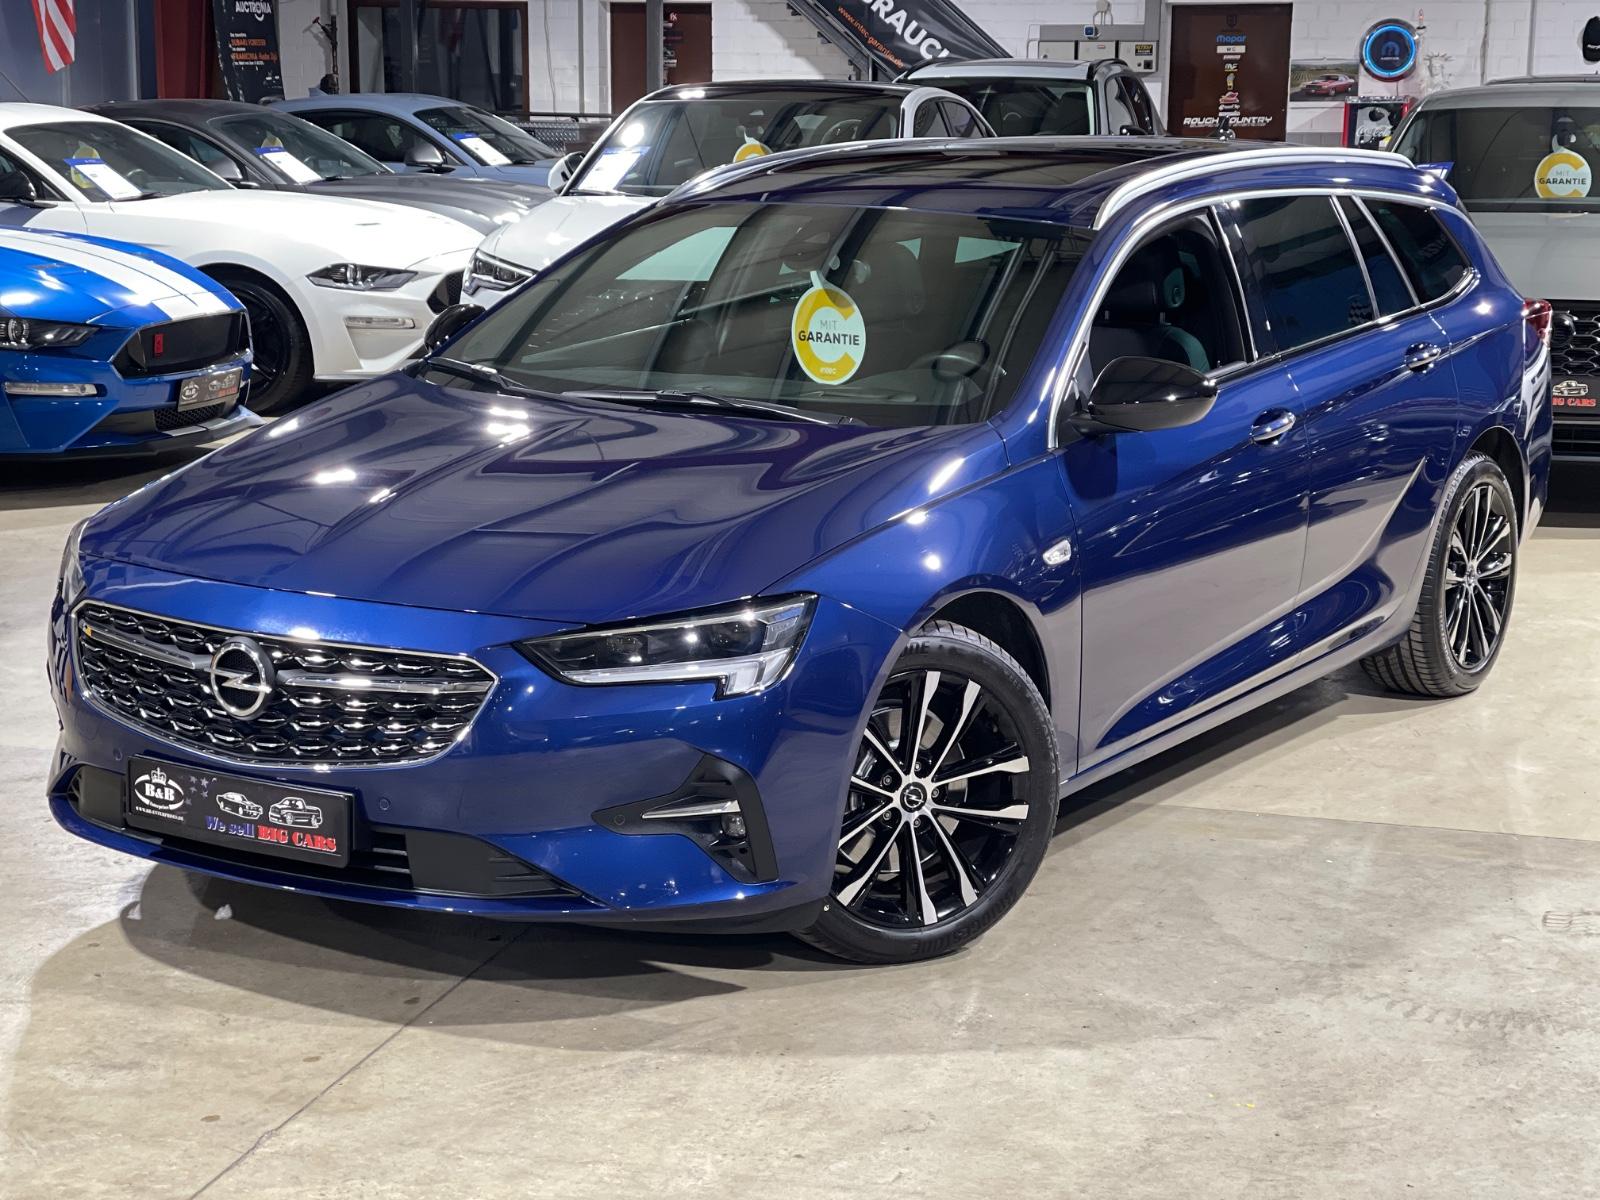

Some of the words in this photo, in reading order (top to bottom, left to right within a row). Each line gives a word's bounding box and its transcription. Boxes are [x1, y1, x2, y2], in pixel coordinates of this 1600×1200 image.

[235, 1, 272, 14] AUCTRONIA
[861, 0, 950, 60] RAUC
[1183, 117, 1219, 125] ROUGH
[1228, 116, 1273, 124] OUNTRY
[1538, 177, 1587, 185] GARANTIE
[819, 319, 838, 331] MIT
[797, 330, 861, 346] GARANTIE
[1567, 397, 1597, 407] CARS
[144, 782, 176, 801] B&B
[205, 815, 226, 833] We
[228, 822, 256, 838] sell
[257, 825, 289, 844] BIG
[291, 831, 337, 852] CARS
